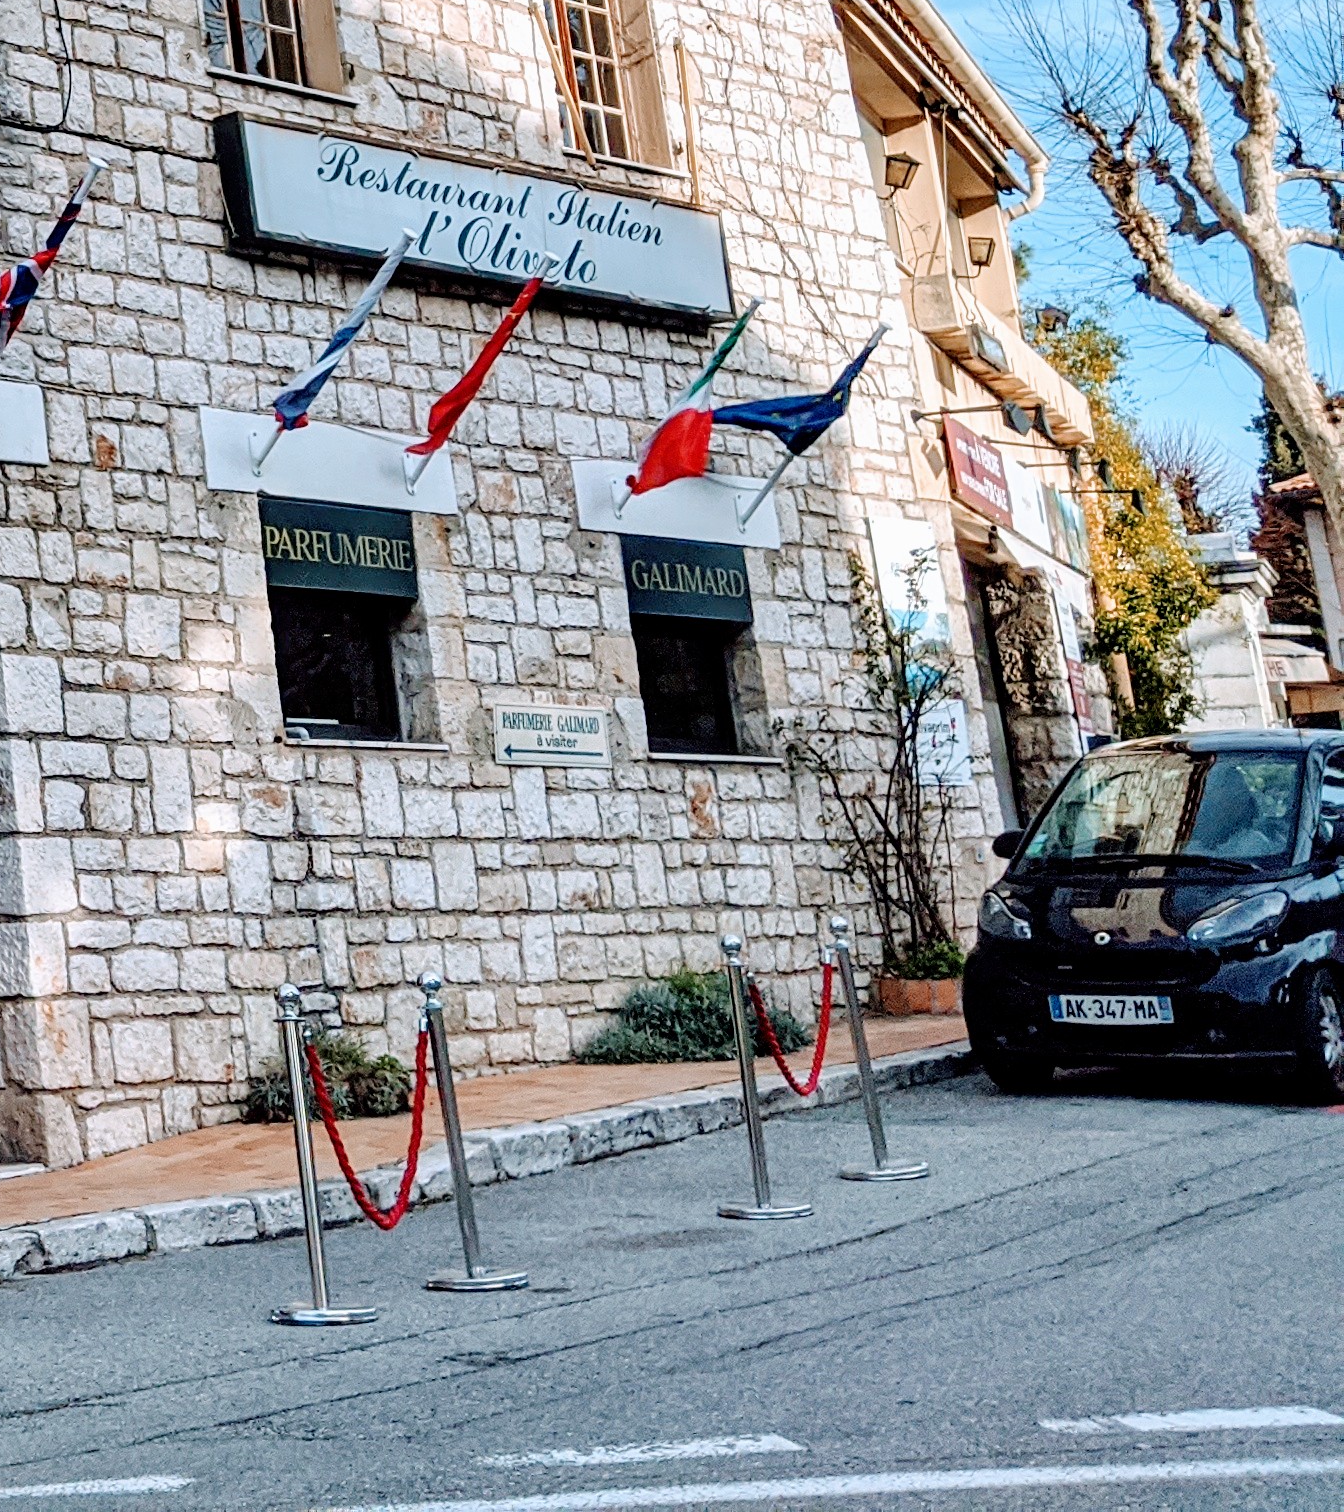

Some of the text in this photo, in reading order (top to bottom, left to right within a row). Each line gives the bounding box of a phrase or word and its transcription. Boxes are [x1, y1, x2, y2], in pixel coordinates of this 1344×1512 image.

[317, 141, 663, 246] Restaurant Italien
[263, 525, 414, 572] PARFUMERIE
[631, 559, 745, 598] GALIMARD
[502, 711, 600, 735] PARFUMERIE GALIMARD
[536, 734, 579, 748] à visiter
